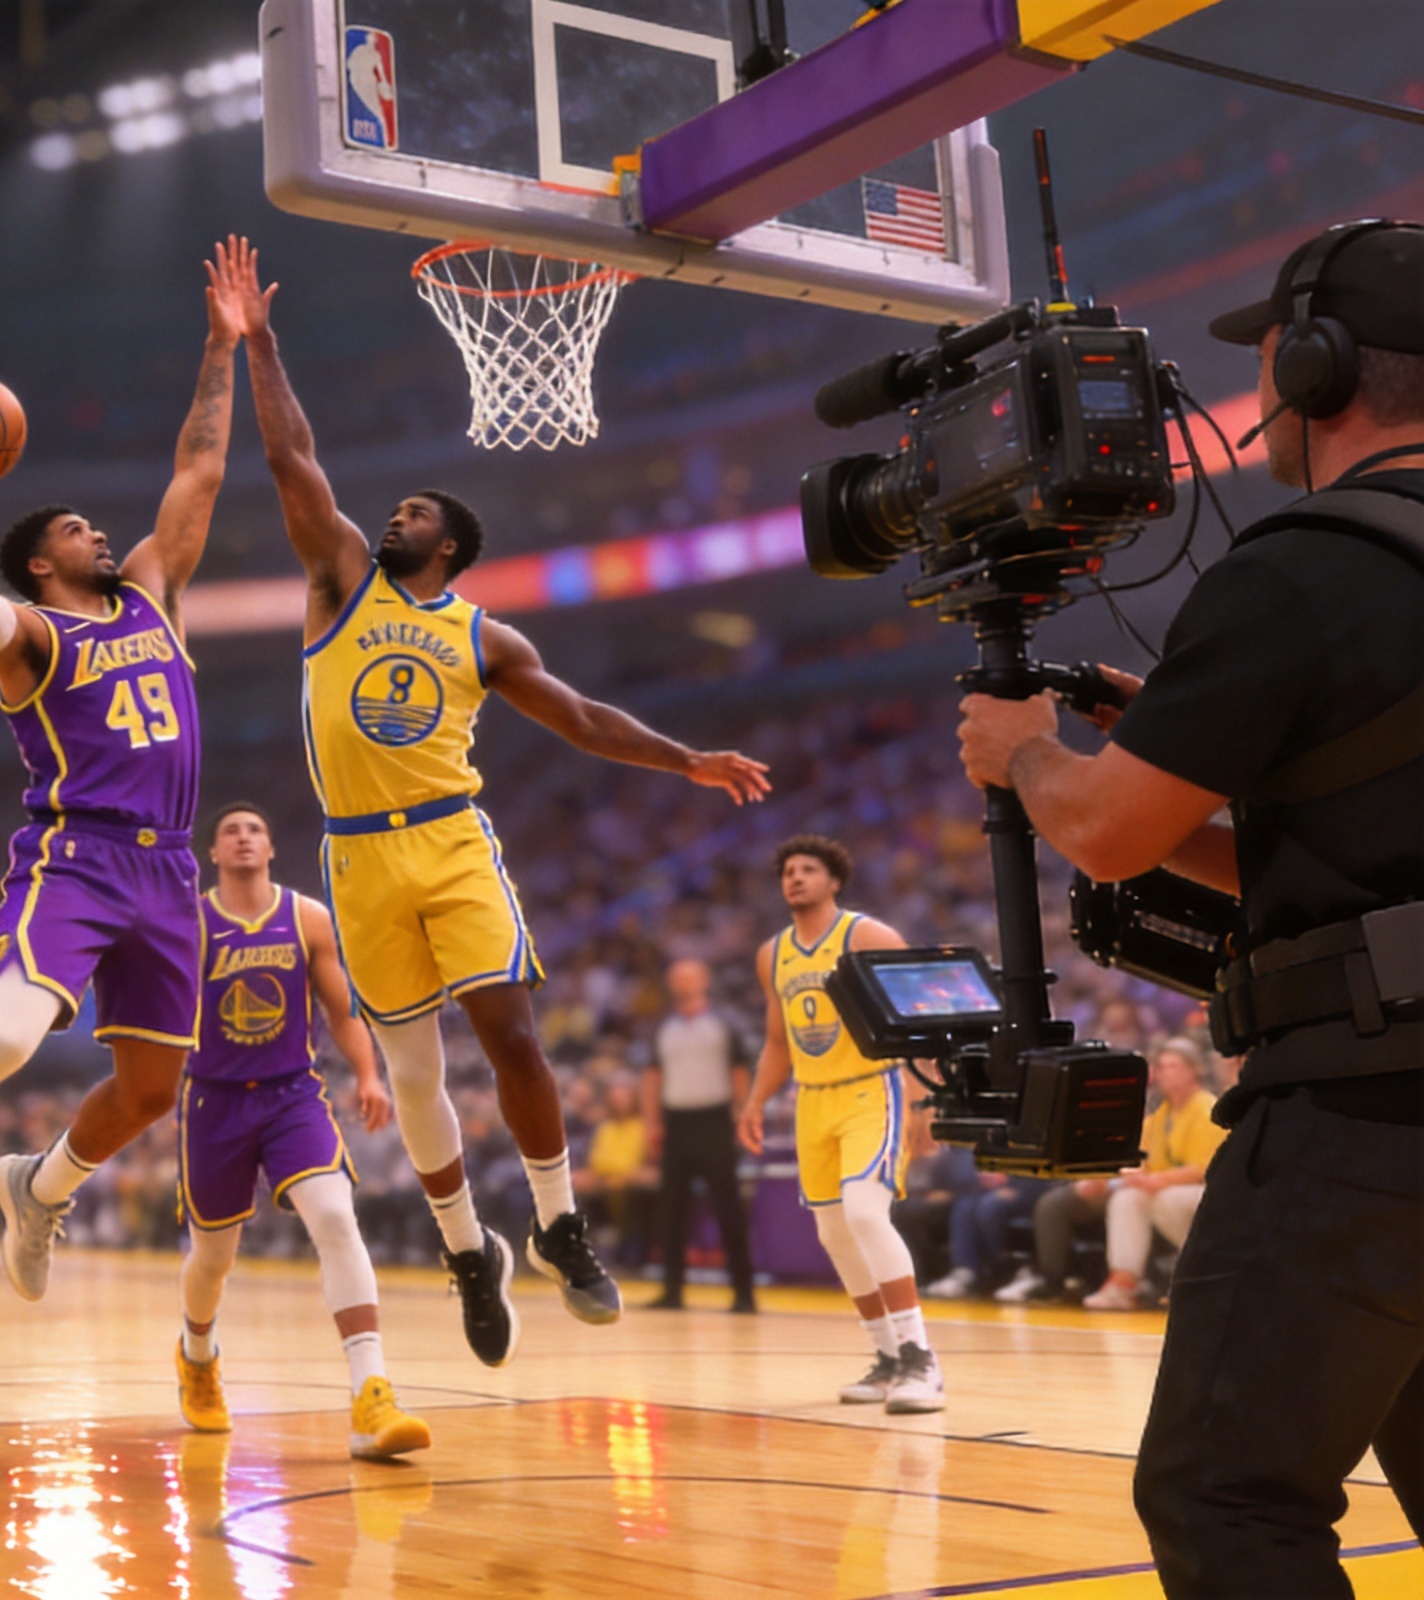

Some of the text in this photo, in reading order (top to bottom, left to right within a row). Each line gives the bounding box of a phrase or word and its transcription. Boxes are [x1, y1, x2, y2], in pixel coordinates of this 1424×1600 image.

[66, 626, 175, 691] LAKERS
[388, 663, 415, 704] 8
[106, 672, 180, 749] 49
